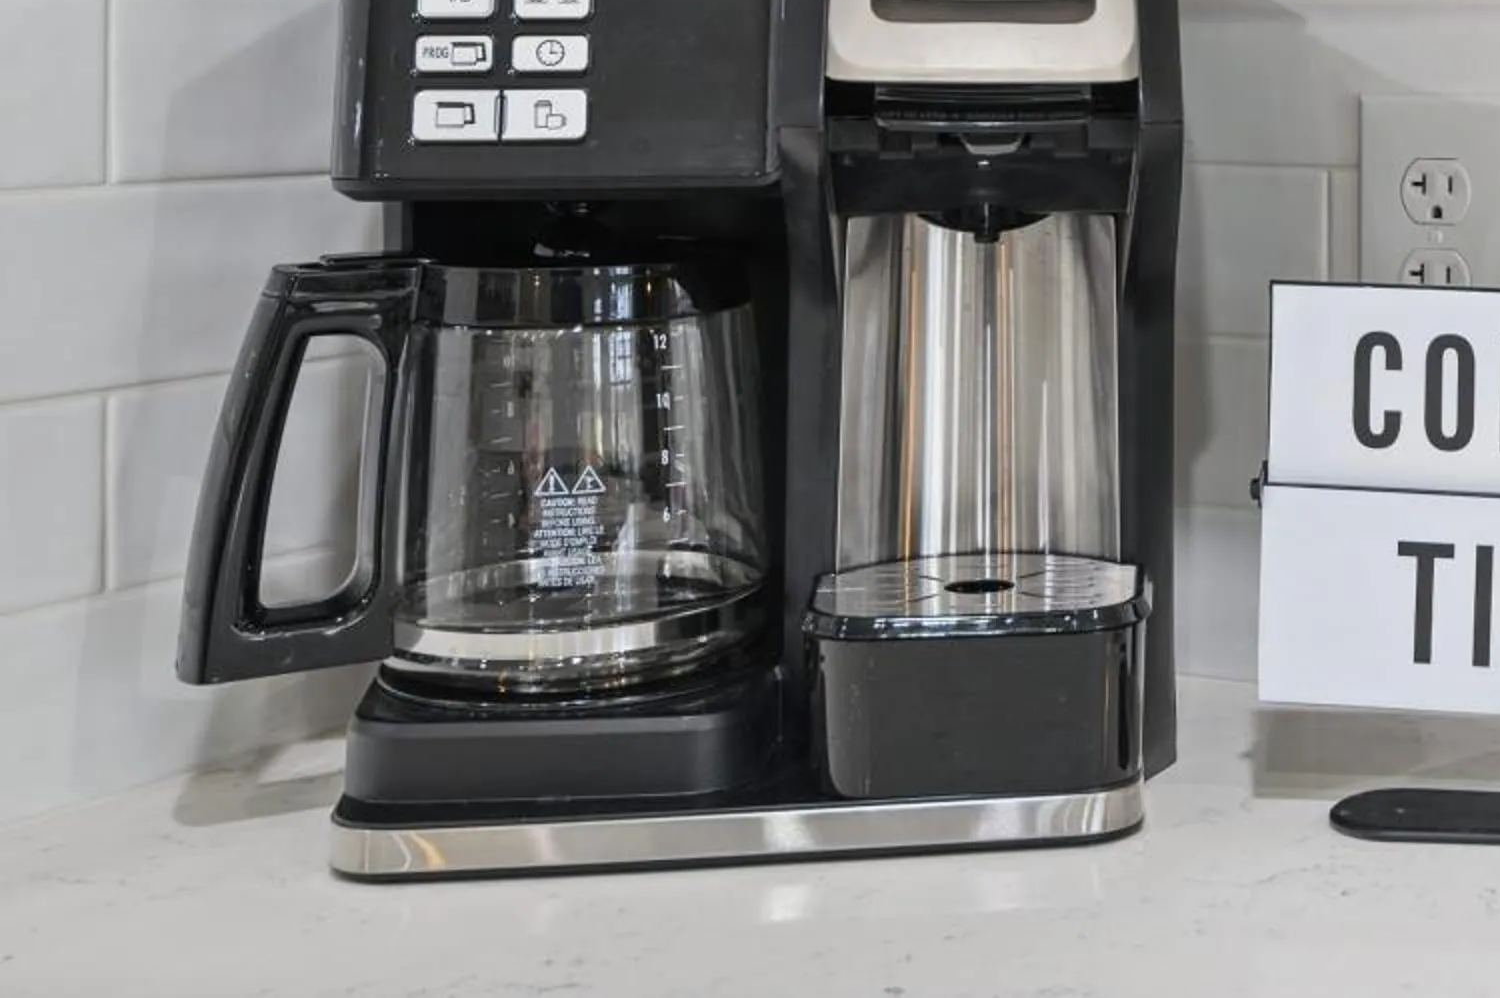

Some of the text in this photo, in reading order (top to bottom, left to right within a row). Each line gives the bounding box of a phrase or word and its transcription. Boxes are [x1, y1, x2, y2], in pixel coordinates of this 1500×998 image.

[422, 46, 450, 59] PROG
[653, 334, 667, 350] 12
[661, 449, 669, 465] 8
[663, 507, 671, 523] 6
